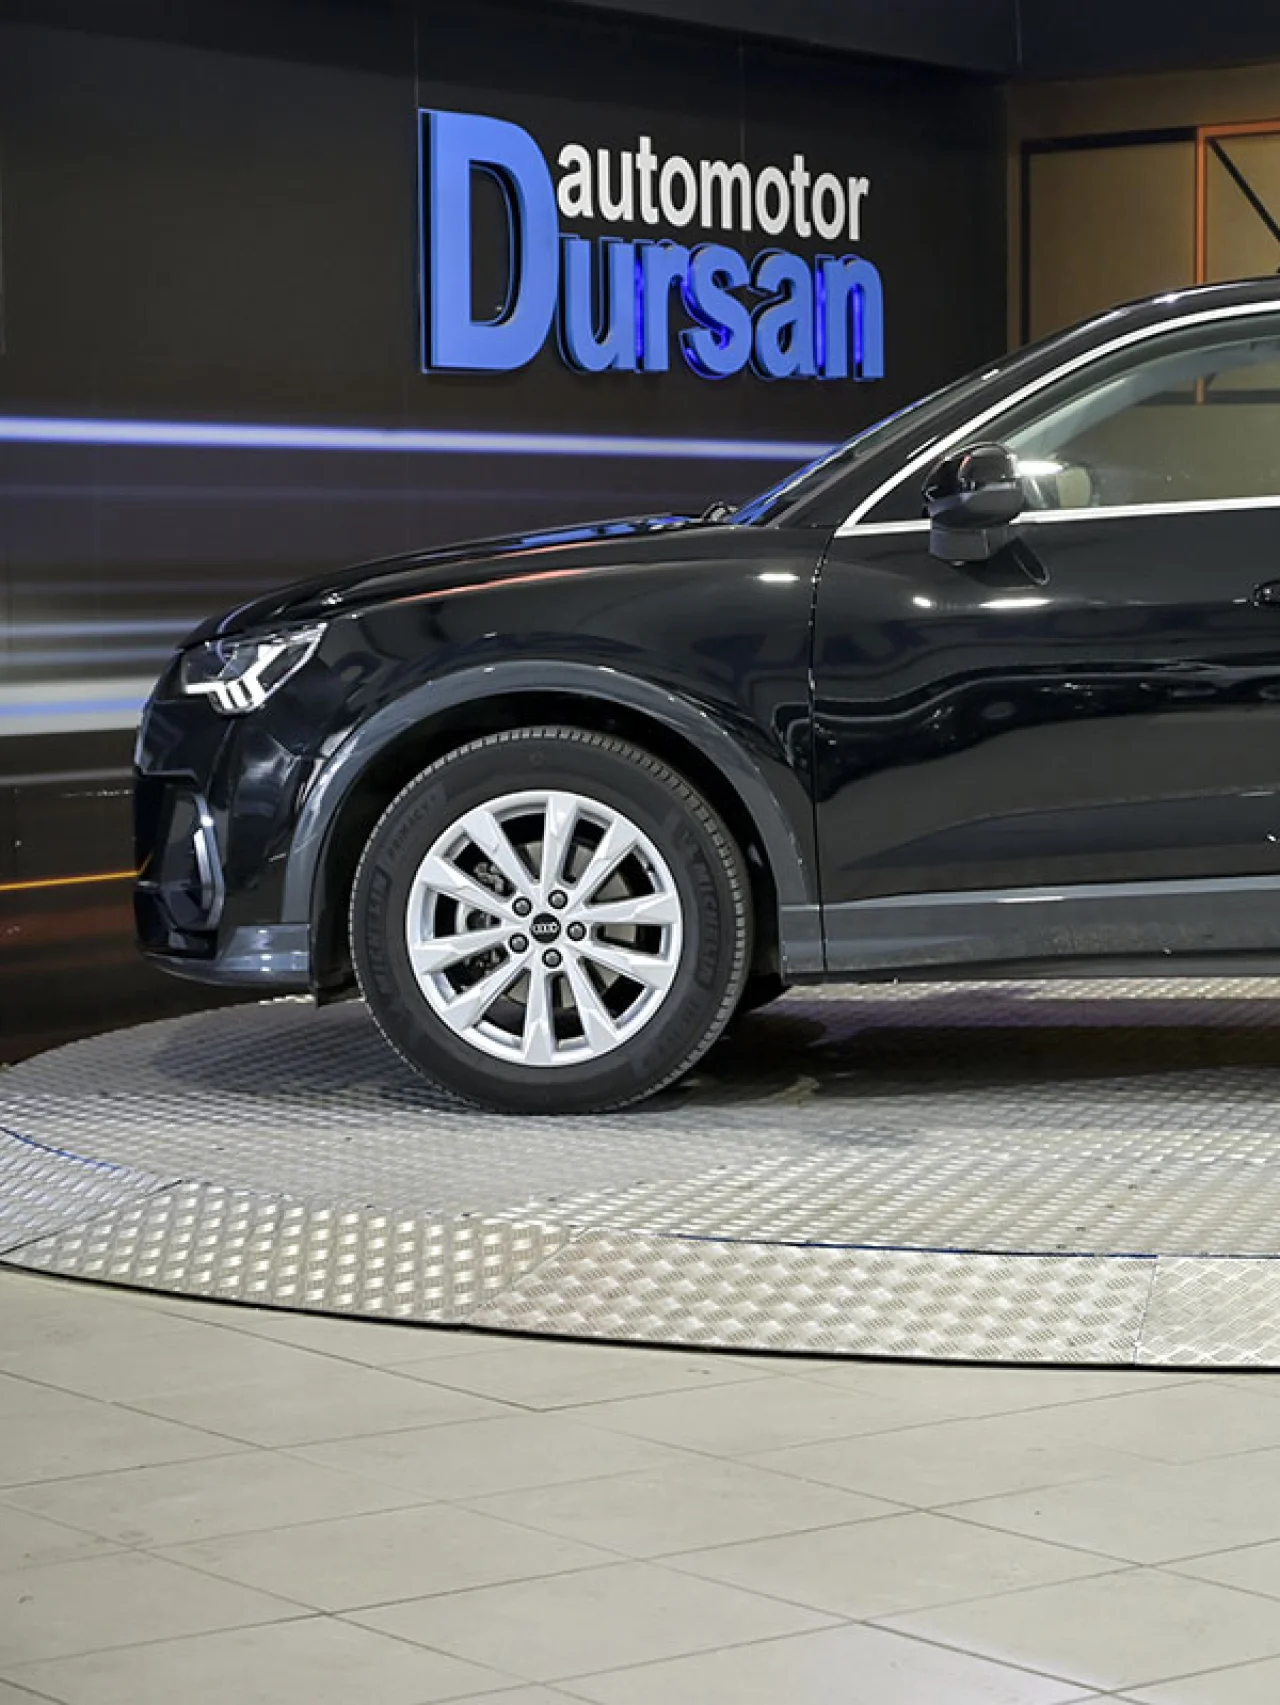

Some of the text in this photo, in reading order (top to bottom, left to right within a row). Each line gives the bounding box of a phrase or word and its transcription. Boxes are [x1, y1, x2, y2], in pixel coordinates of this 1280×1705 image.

[418, 108, 885, 380] Dursan
[557, 136, 869, 241] automotor
[691, 857, 720, 987] MICHELIN
